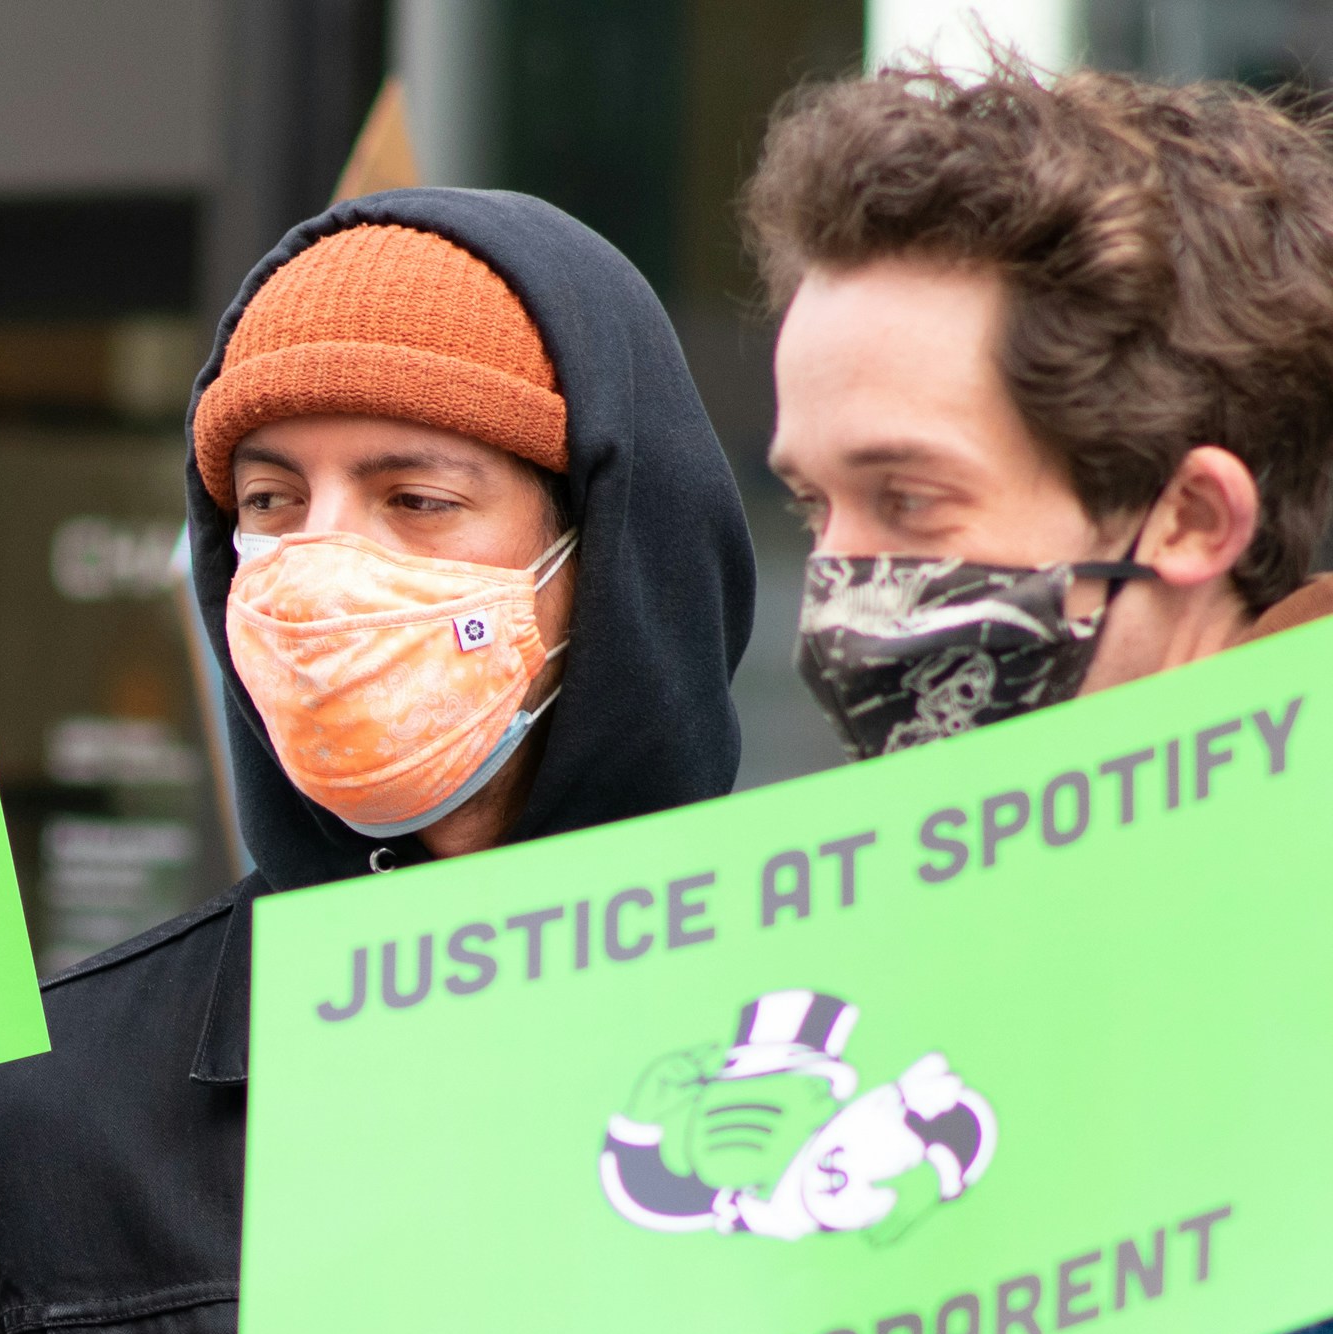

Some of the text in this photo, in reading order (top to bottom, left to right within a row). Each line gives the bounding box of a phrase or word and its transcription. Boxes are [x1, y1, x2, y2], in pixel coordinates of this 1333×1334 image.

[314, 696, 1306, 1024] JUSTICE AT SPOTIFY
